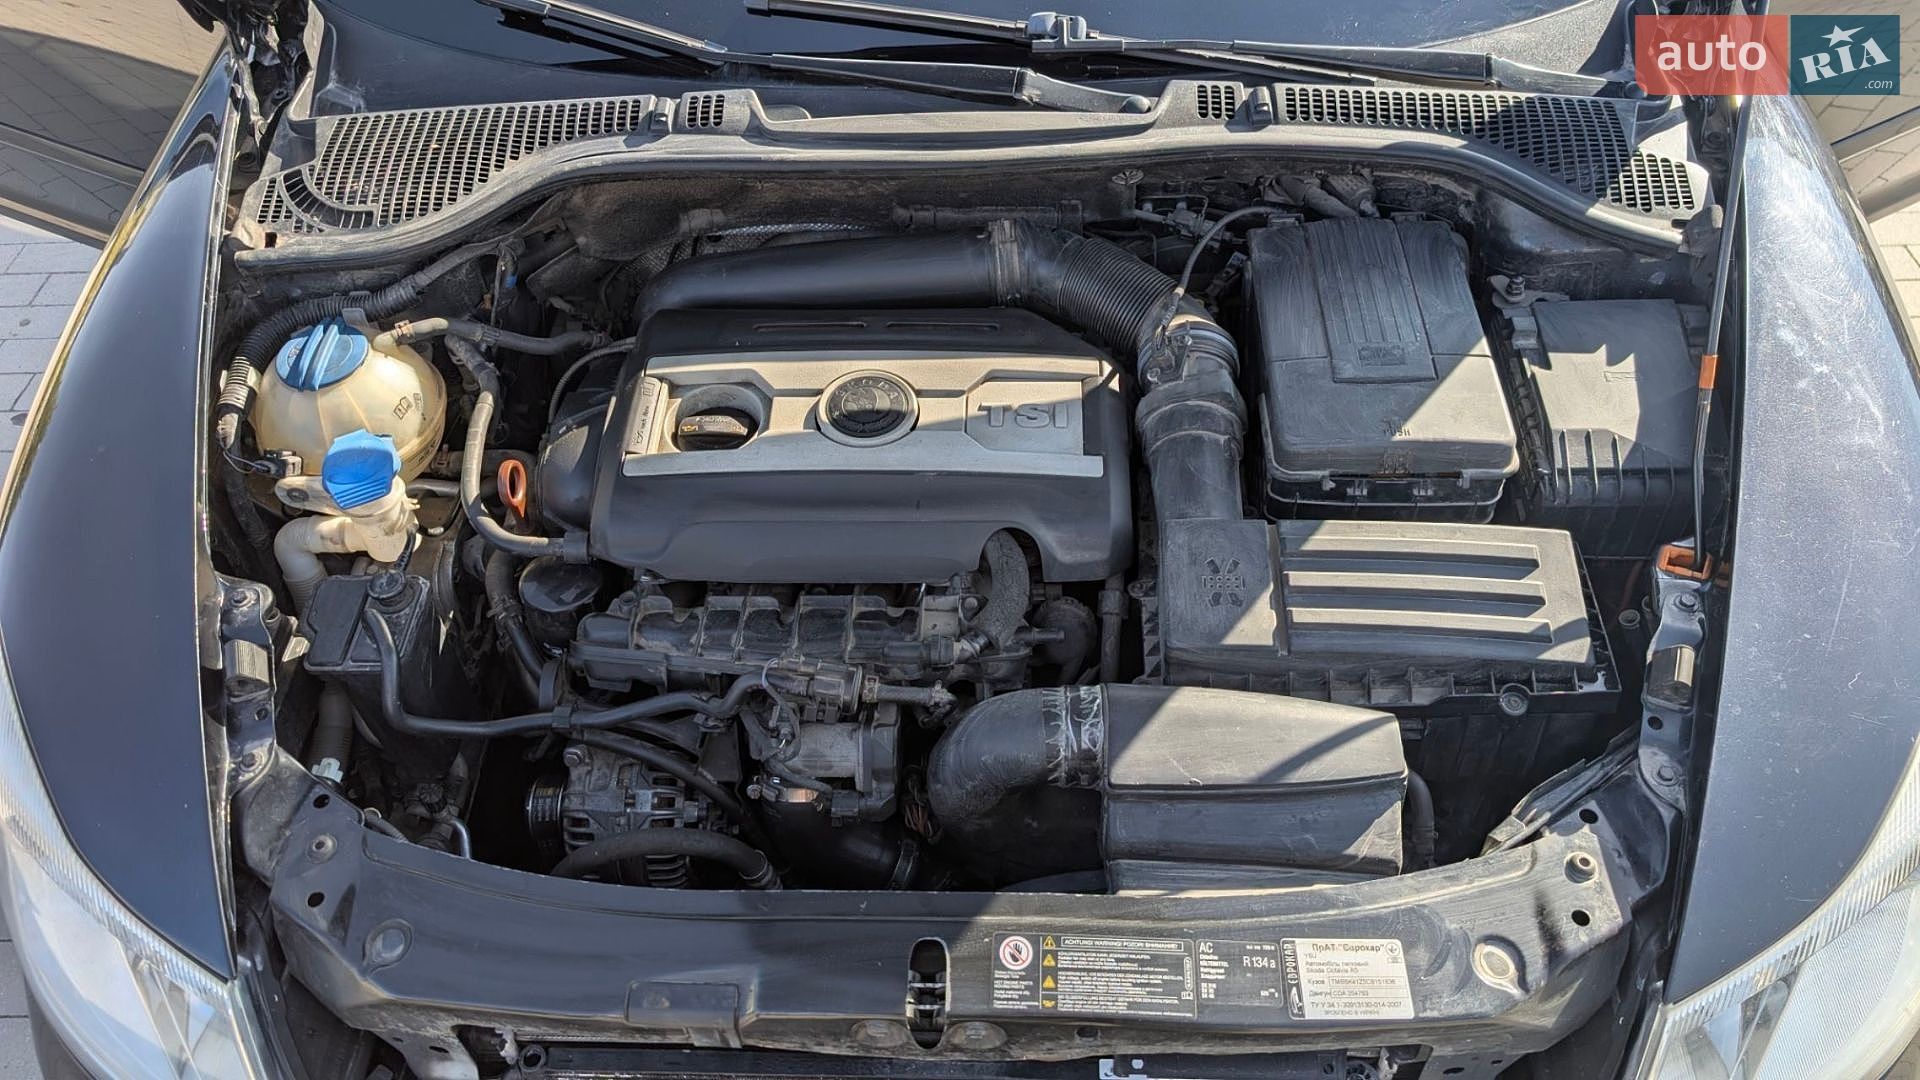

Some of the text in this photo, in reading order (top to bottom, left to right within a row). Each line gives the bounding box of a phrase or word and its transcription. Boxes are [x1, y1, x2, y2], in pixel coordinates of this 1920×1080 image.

[977, 402, 1069, 429] TSI
[1199, 942, 1213, 953] AC
[1243, 956, 1251, 967] R
